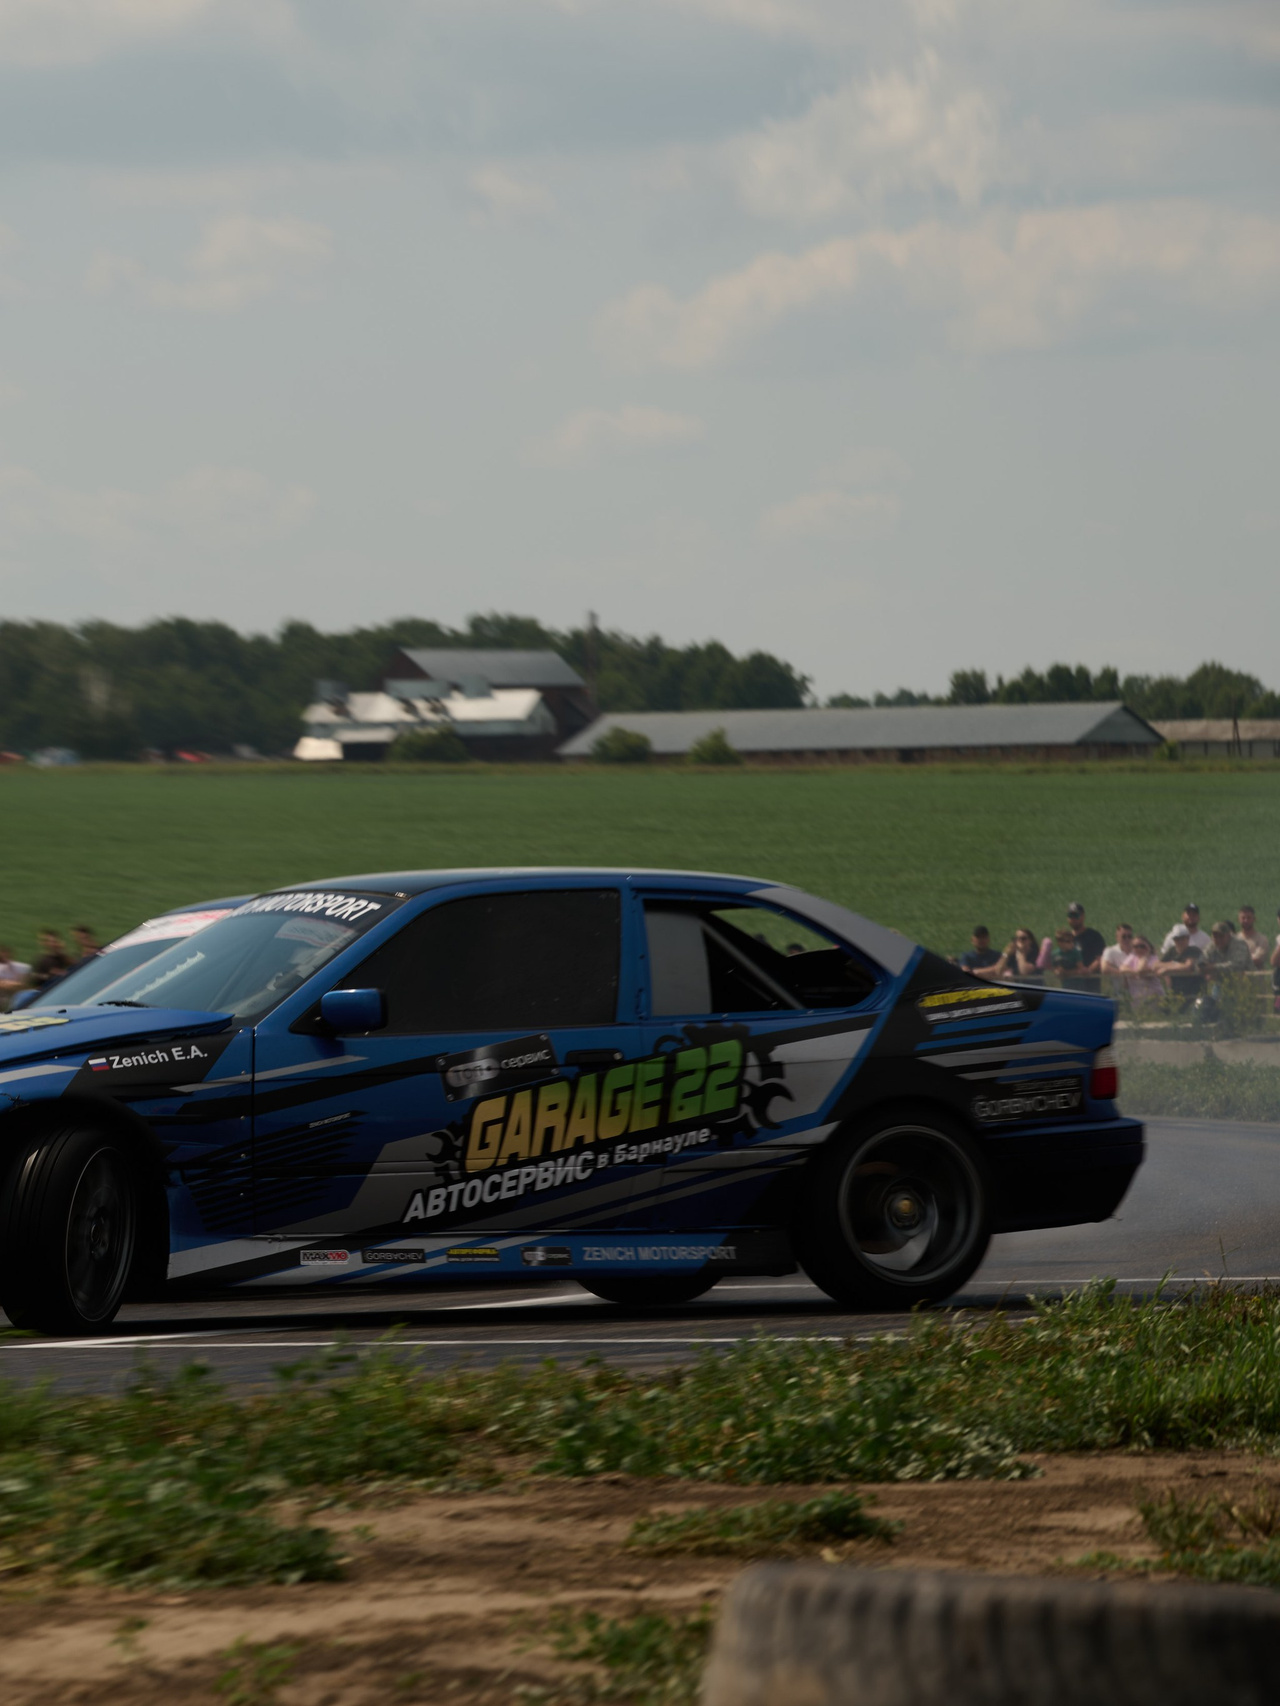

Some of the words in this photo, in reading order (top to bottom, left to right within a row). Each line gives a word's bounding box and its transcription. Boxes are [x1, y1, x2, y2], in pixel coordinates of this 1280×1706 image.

[109, 1050, 169, 1069] Zenich
[171, 1045, 208, 1061] E.A.
[501, 1049, 551, 1070] сервис
[464, 1056, 667, 1173] GARAGE
[668, 1039, 743, 1123] 22
[403, 1151, 596, 1223] АВТОСЕРВИС
[596, 1153, 610, 1169] в
[582, 1247, 636, 1261] ZENICH
[637, 1246, 737, 1260] MOTORSPORT
